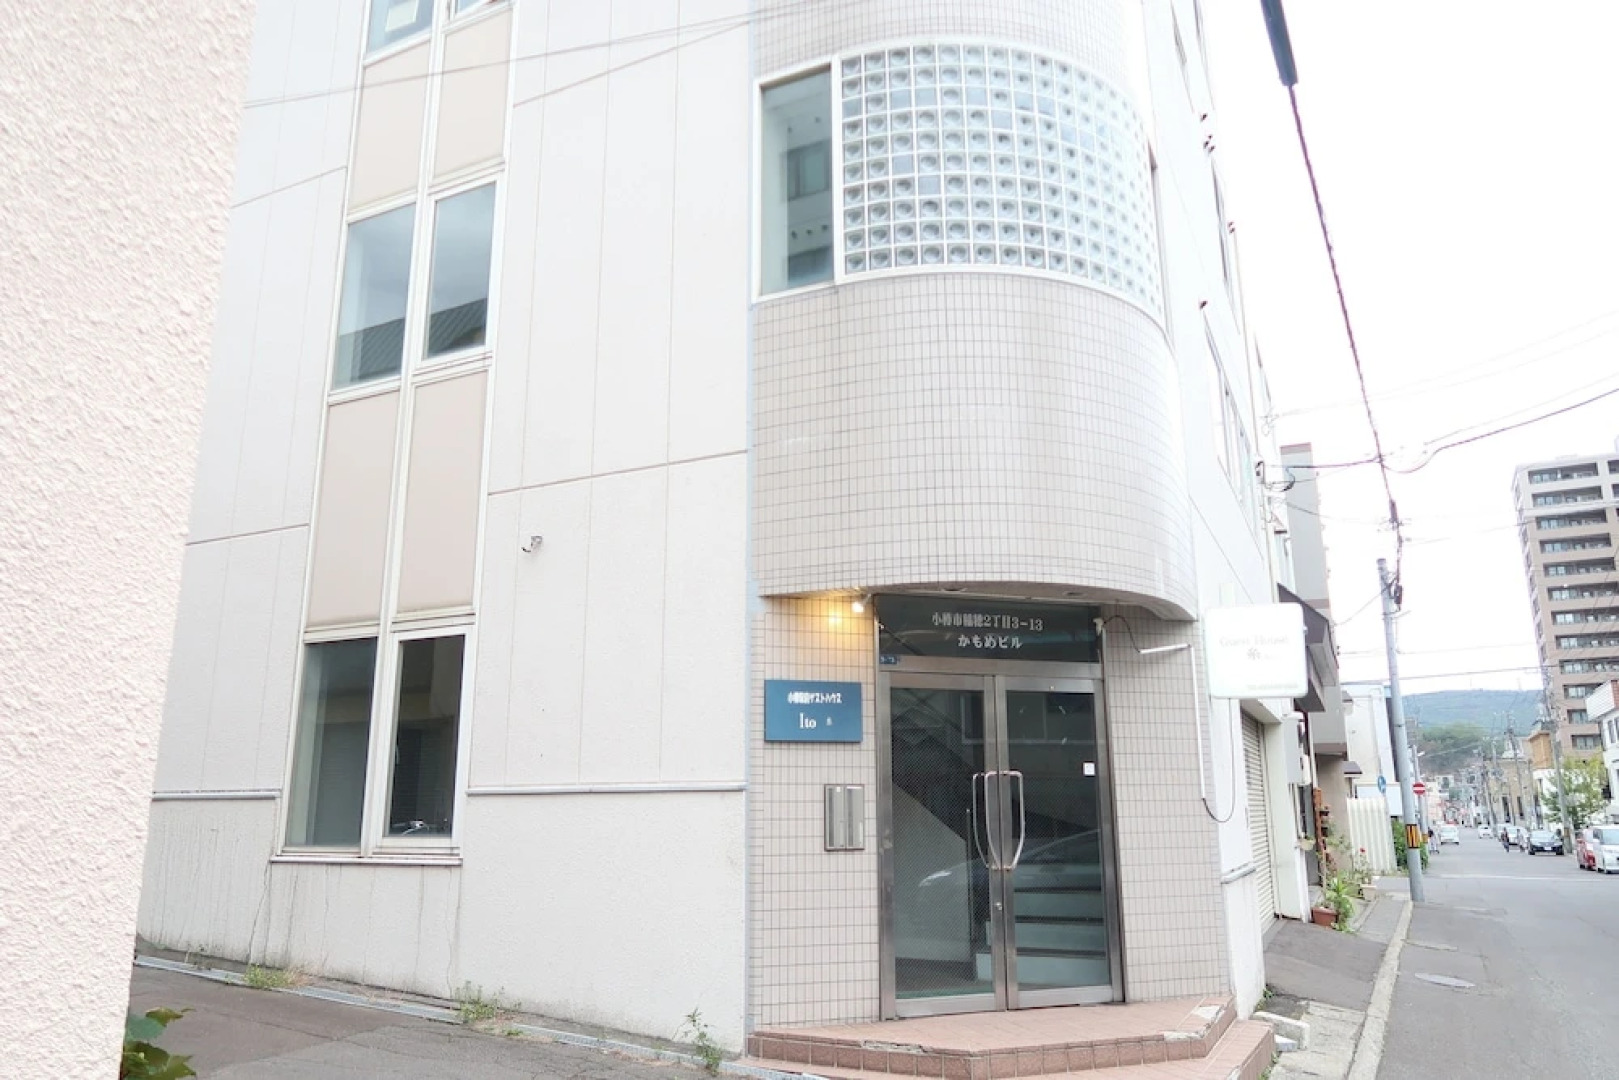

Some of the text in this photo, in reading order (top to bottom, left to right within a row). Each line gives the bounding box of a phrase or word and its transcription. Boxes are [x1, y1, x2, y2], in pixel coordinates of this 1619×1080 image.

[958, 634, 1022, 649] かもめビル
